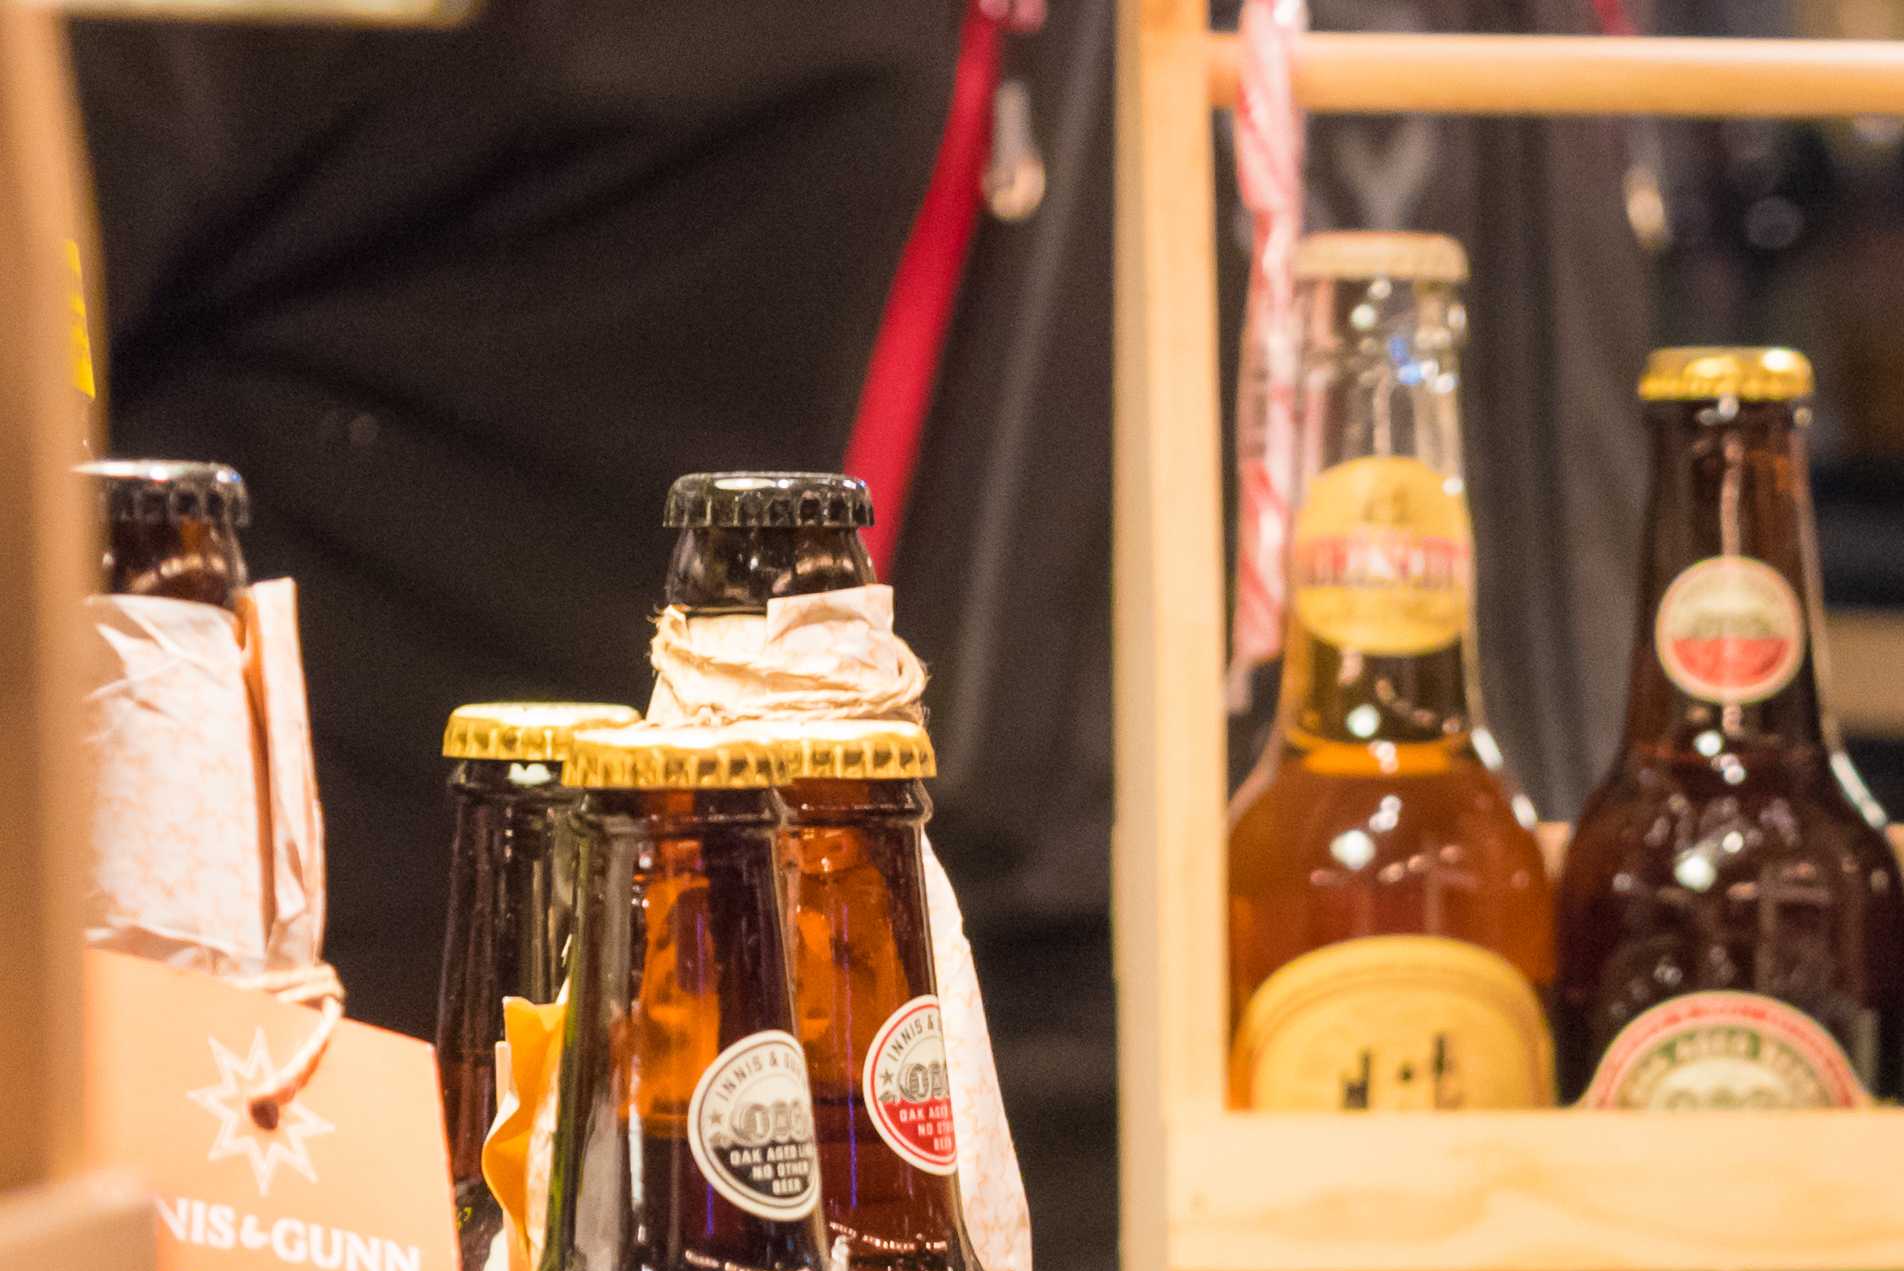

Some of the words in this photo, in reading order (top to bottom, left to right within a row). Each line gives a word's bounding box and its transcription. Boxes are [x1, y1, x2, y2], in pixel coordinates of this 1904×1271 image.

[888, 1018, 923, 1062] INNIS
[717, 1054, 763, 1102] INNIS
[899, 1106, 924, 1122] OAK
[918, 1120, 934, 1136] NO
[730, 1147, 761, 1166] OAK
[752, 1162, 774, 1181] NO
[772, 1178, 800, 1195] BEER
